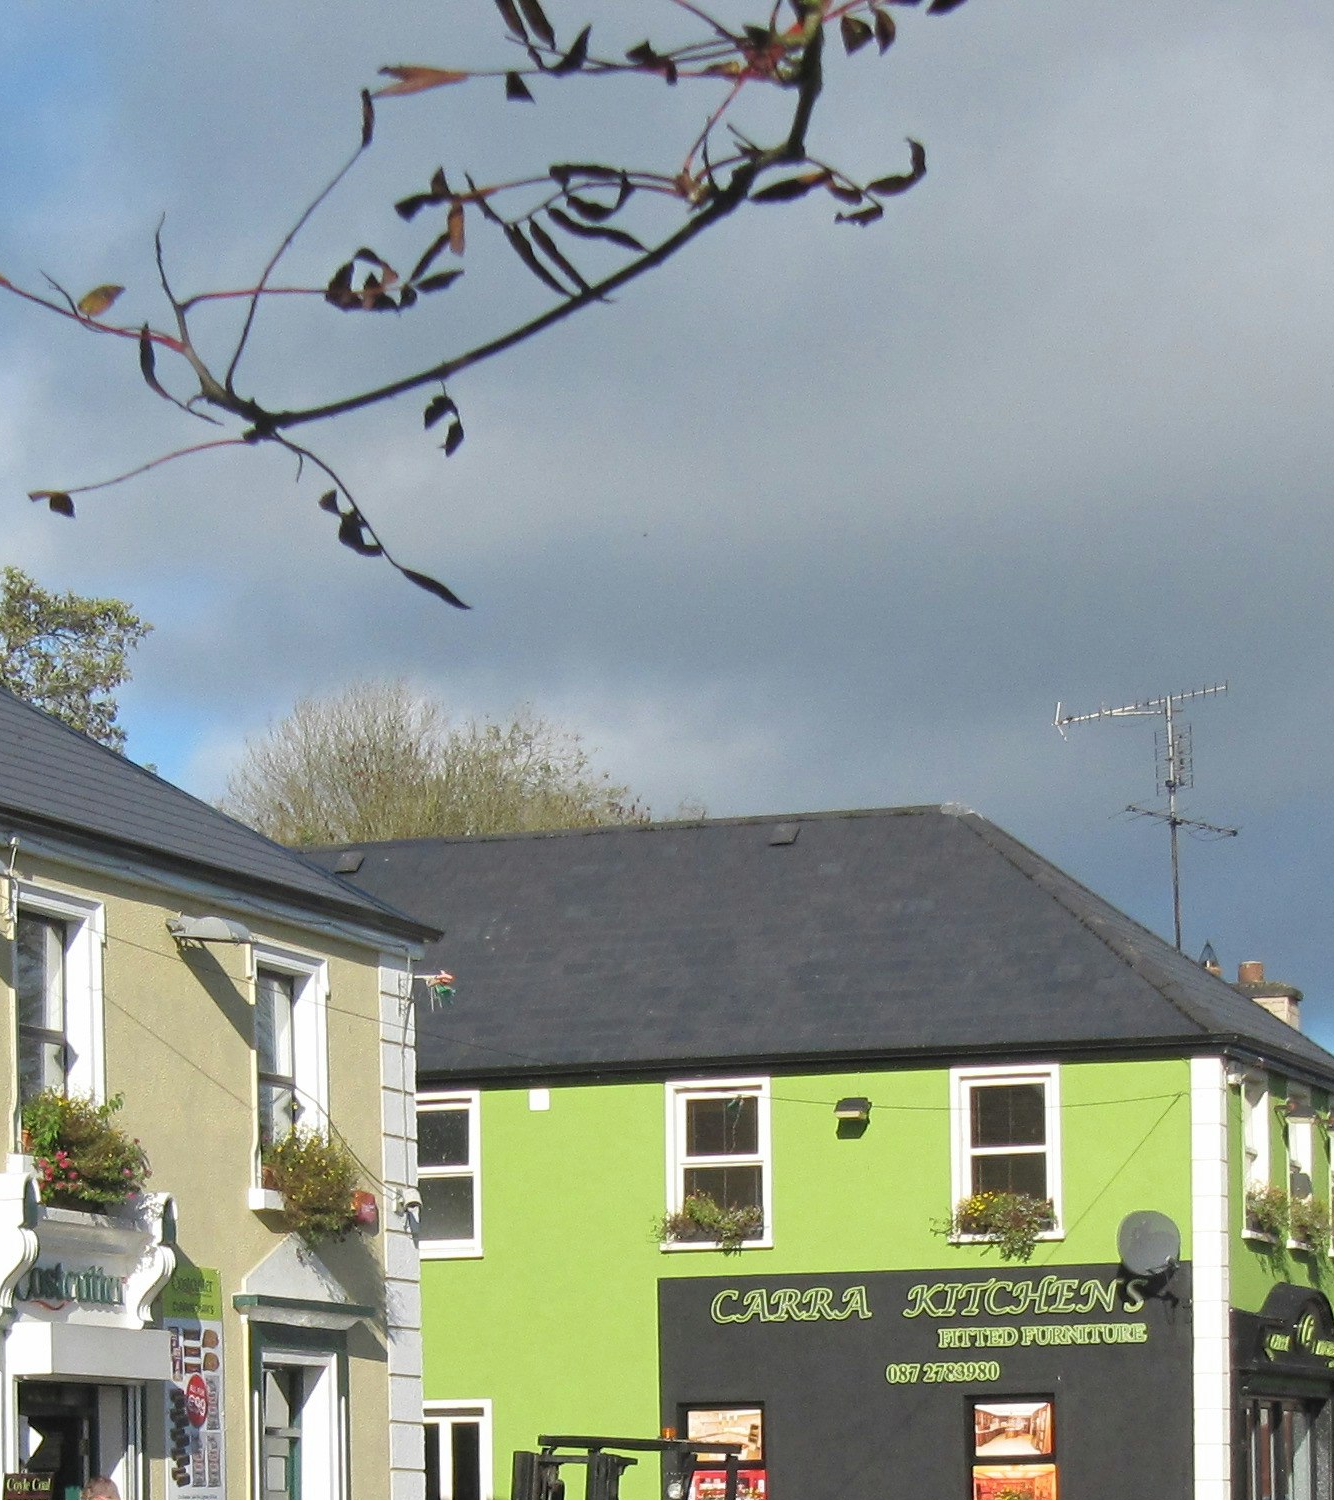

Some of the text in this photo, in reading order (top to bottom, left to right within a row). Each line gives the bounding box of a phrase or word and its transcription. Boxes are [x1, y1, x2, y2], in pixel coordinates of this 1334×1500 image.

[710, 1286, 873, 1324] CARRA
[937, 1322, 1149, 1349] FITTED FURNITURE
[885, 1360, 1001, 1385] 087 2783980
